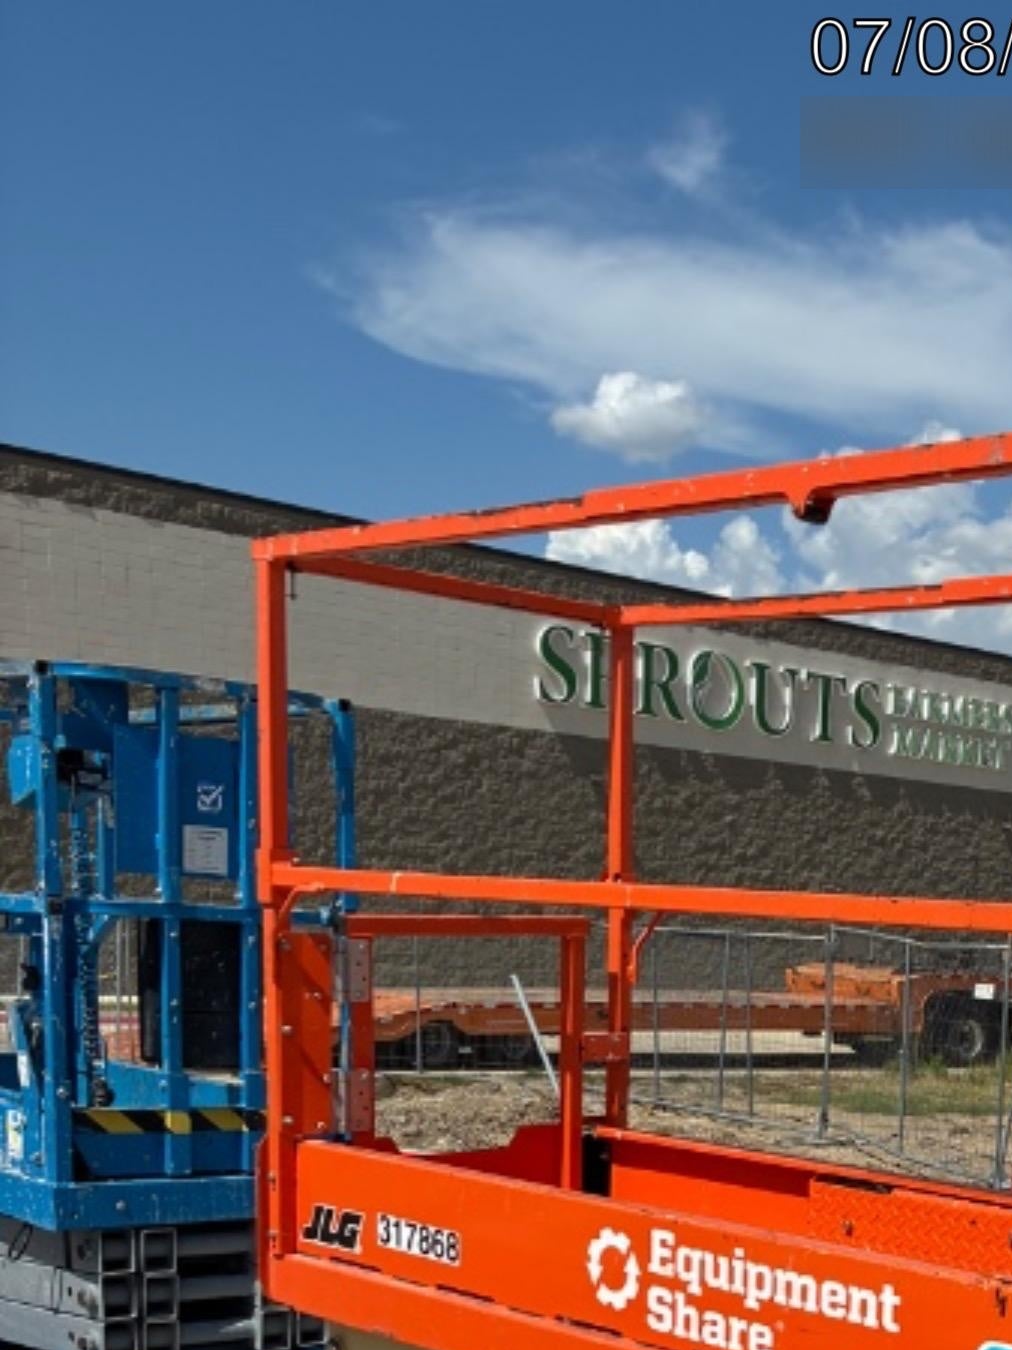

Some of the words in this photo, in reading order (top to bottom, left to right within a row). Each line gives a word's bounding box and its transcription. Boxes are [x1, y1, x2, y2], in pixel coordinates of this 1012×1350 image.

[301, 1204, 364, 1253] JLG
[377, 1212, 460, 1264] 317868
[648, 1228, 901, 1334] Equipment
